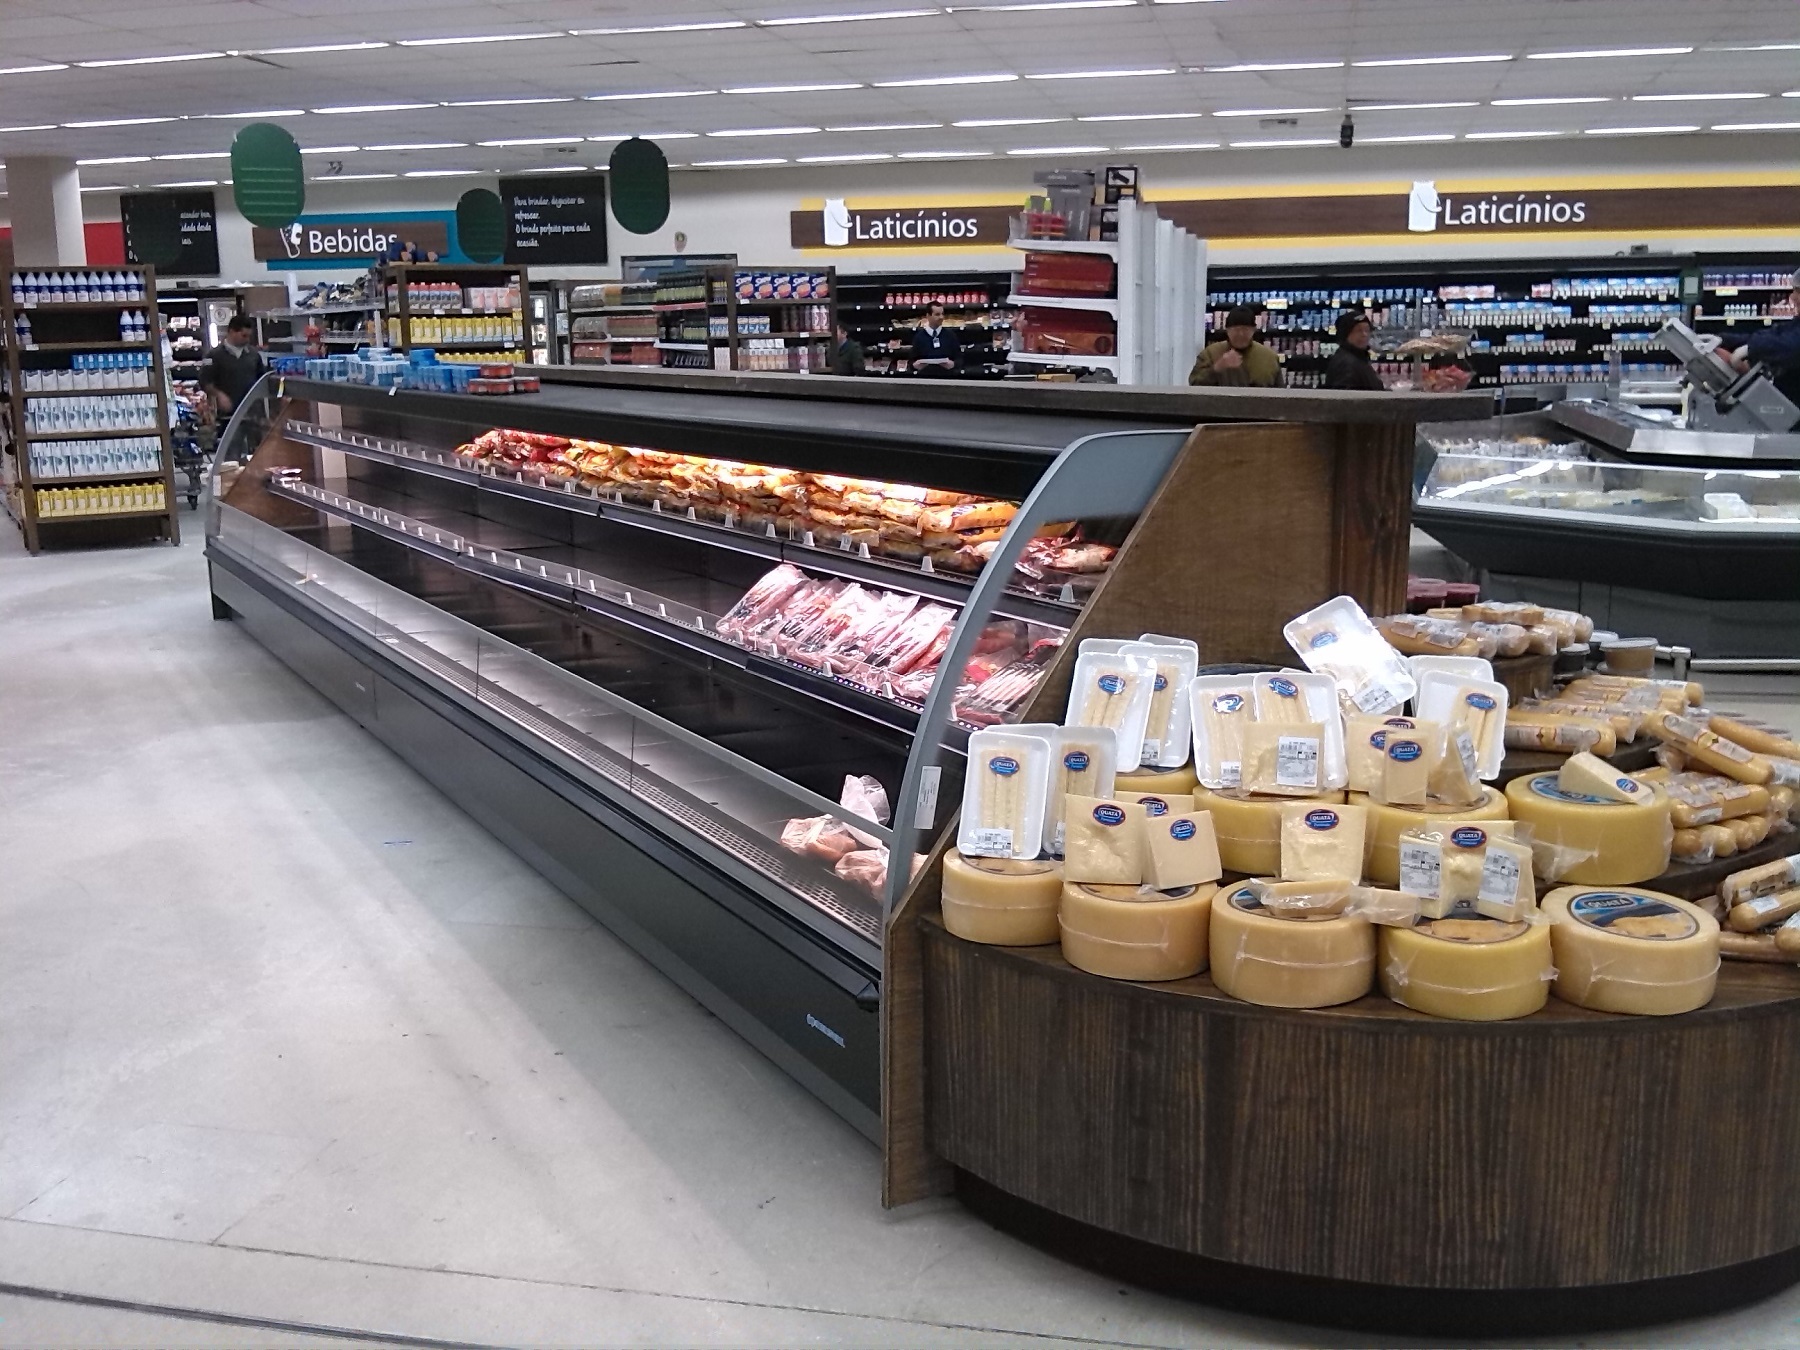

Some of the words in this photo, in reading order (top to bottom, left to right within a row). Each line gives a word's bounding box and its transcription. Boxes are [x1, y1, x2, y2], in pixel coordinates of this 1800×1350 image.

[514, 196, 527, 206] Para
[1444, 194, 1586, 225] Laticínios
[515, 224, 520, 233] O
[562, 225, 575, 235] para
[576, 222, 591, 232] cada
[855, 211, 978, 239] Laticínios
